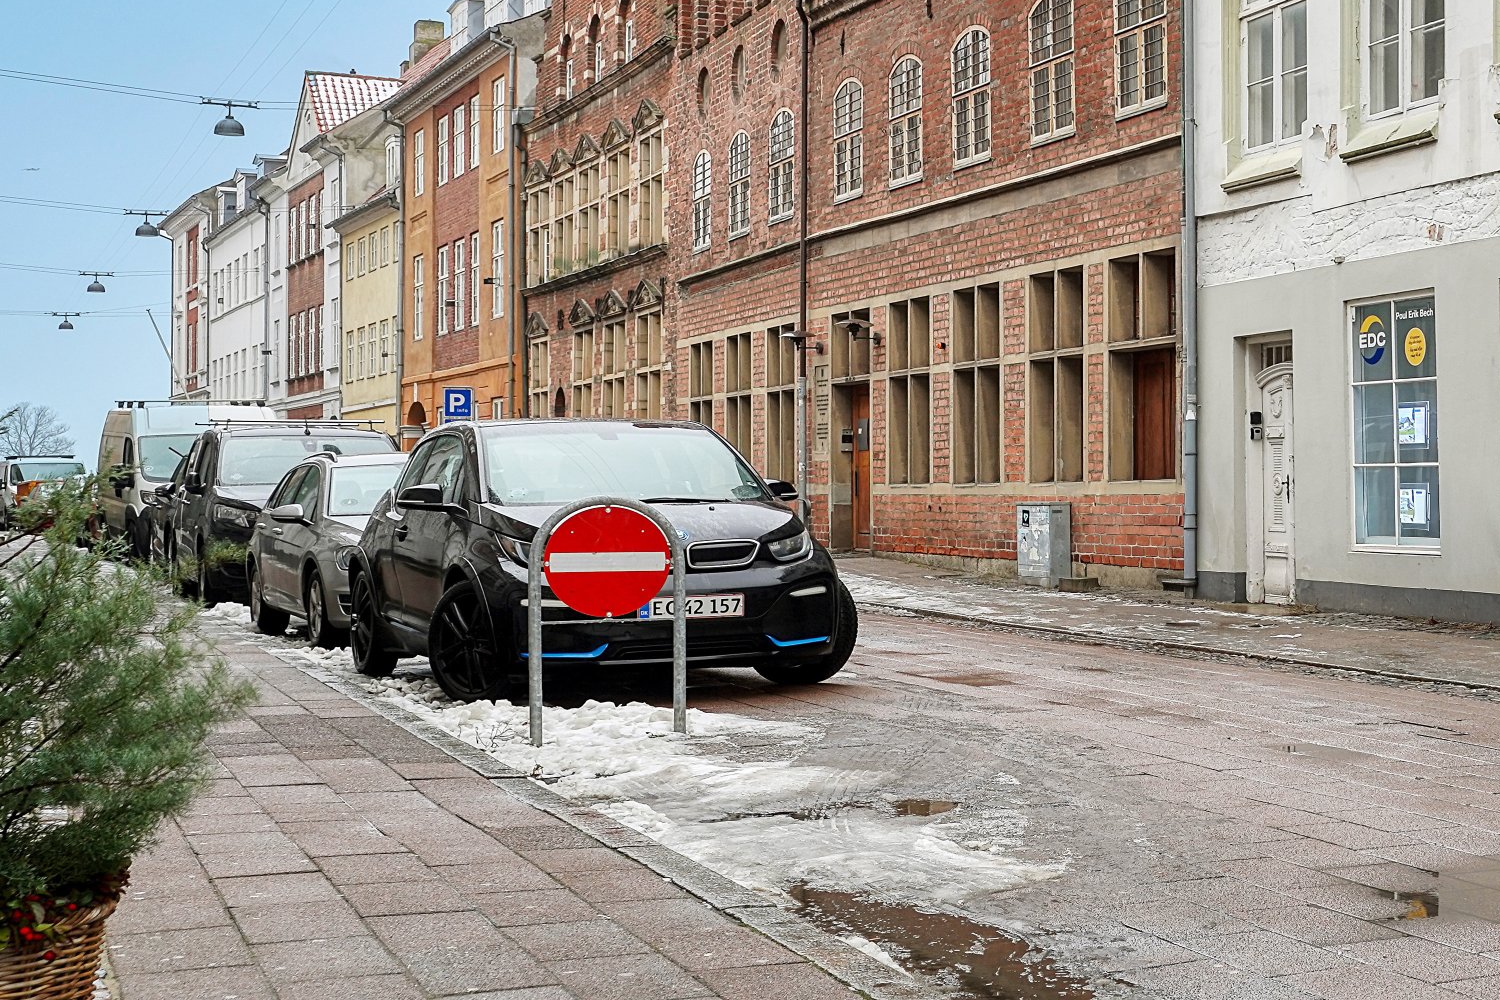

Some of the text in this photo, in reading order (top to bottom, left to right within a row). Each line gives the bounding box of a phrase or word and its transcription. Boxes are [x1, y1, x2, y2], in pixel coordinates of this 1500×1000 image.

[1395, 308, 1434, 320] Poul Erik Bech
[1359, 331, 1386, 349] EDC
[684, 599, 704, 615] 42
[710, 598, 741, 614] 157
